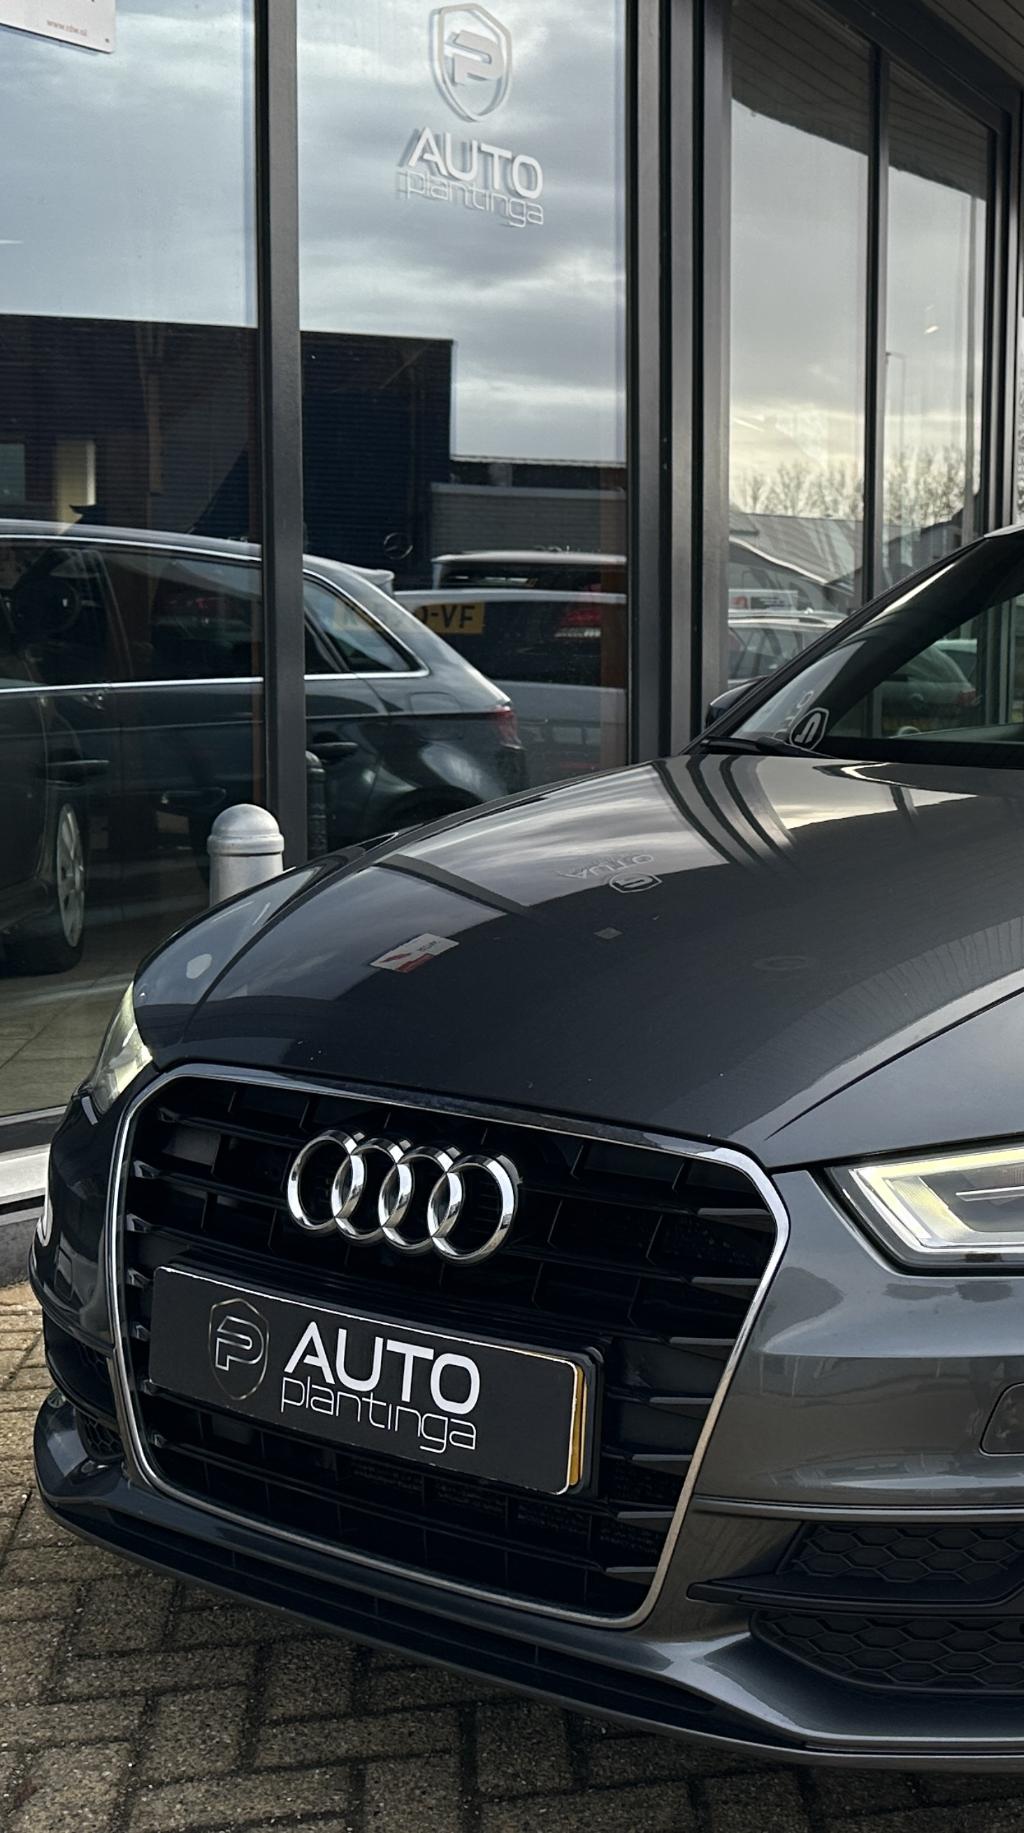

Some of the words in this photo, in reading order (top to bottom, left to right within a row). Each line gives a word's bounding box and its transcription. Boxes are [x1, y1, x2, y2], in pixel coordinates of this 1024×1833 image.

[405, 169, 544, 228] plantinga
[407, 127, 543, 199] AUTO
[284, 1321, 480, 1415] AUTO
[281, 1376, 477, 1454] plantinga
